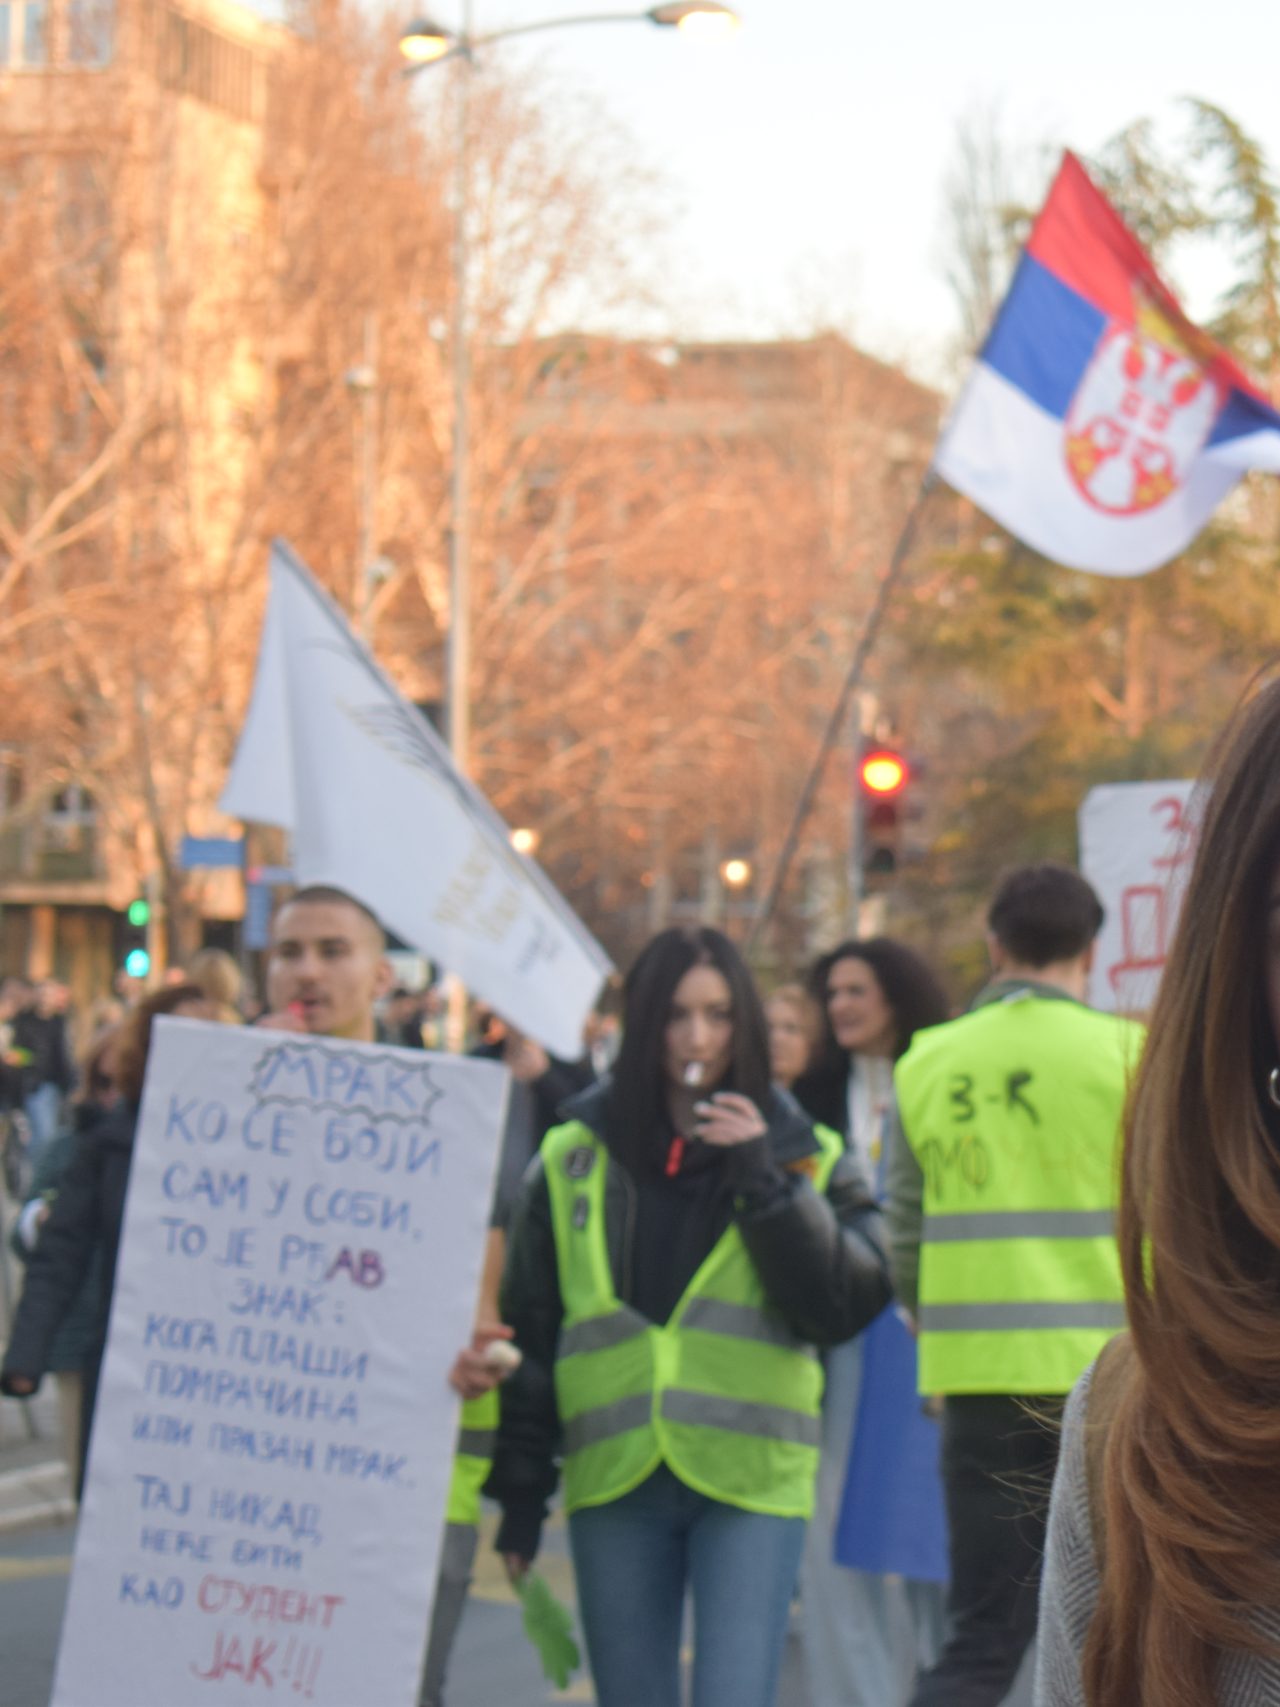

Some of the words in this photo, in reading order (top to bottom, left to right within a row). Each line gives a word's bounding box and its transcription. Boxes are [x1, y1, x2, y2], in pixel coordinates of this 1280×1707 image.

[260, 1047, 419, 1110] МРАК
[164, 1093, 229, 1146] КО
[242, 1106, 297, 1157] СЕ
[323, 1117, 443, 1177] БОЈИ
[162, 1160, 249, 1211] САМ
[263, 1177, 291, 1219] У
[159, 1216, 208, 1258] ТО
[214, 1227, 258, 1270] ЈЕ
[143, 1312, 219, 1354] КОГА
[226, 1325, 370, 1381] ПЛАШИ
[142, 1360, 360, 1424] ПОМРАЧИНА
[131, 1412, 195, 1447] ИЛИ
[207, 1422, 316, 1471] ПРАЗАН
[135, 1473, 192, 1517] ТАЈ
[231, 1538, 303, 1570] БИТИ
[118, 1572, 185, 1609] КАО
[197, 1573, 346, 1629] СТУДЕНТ
